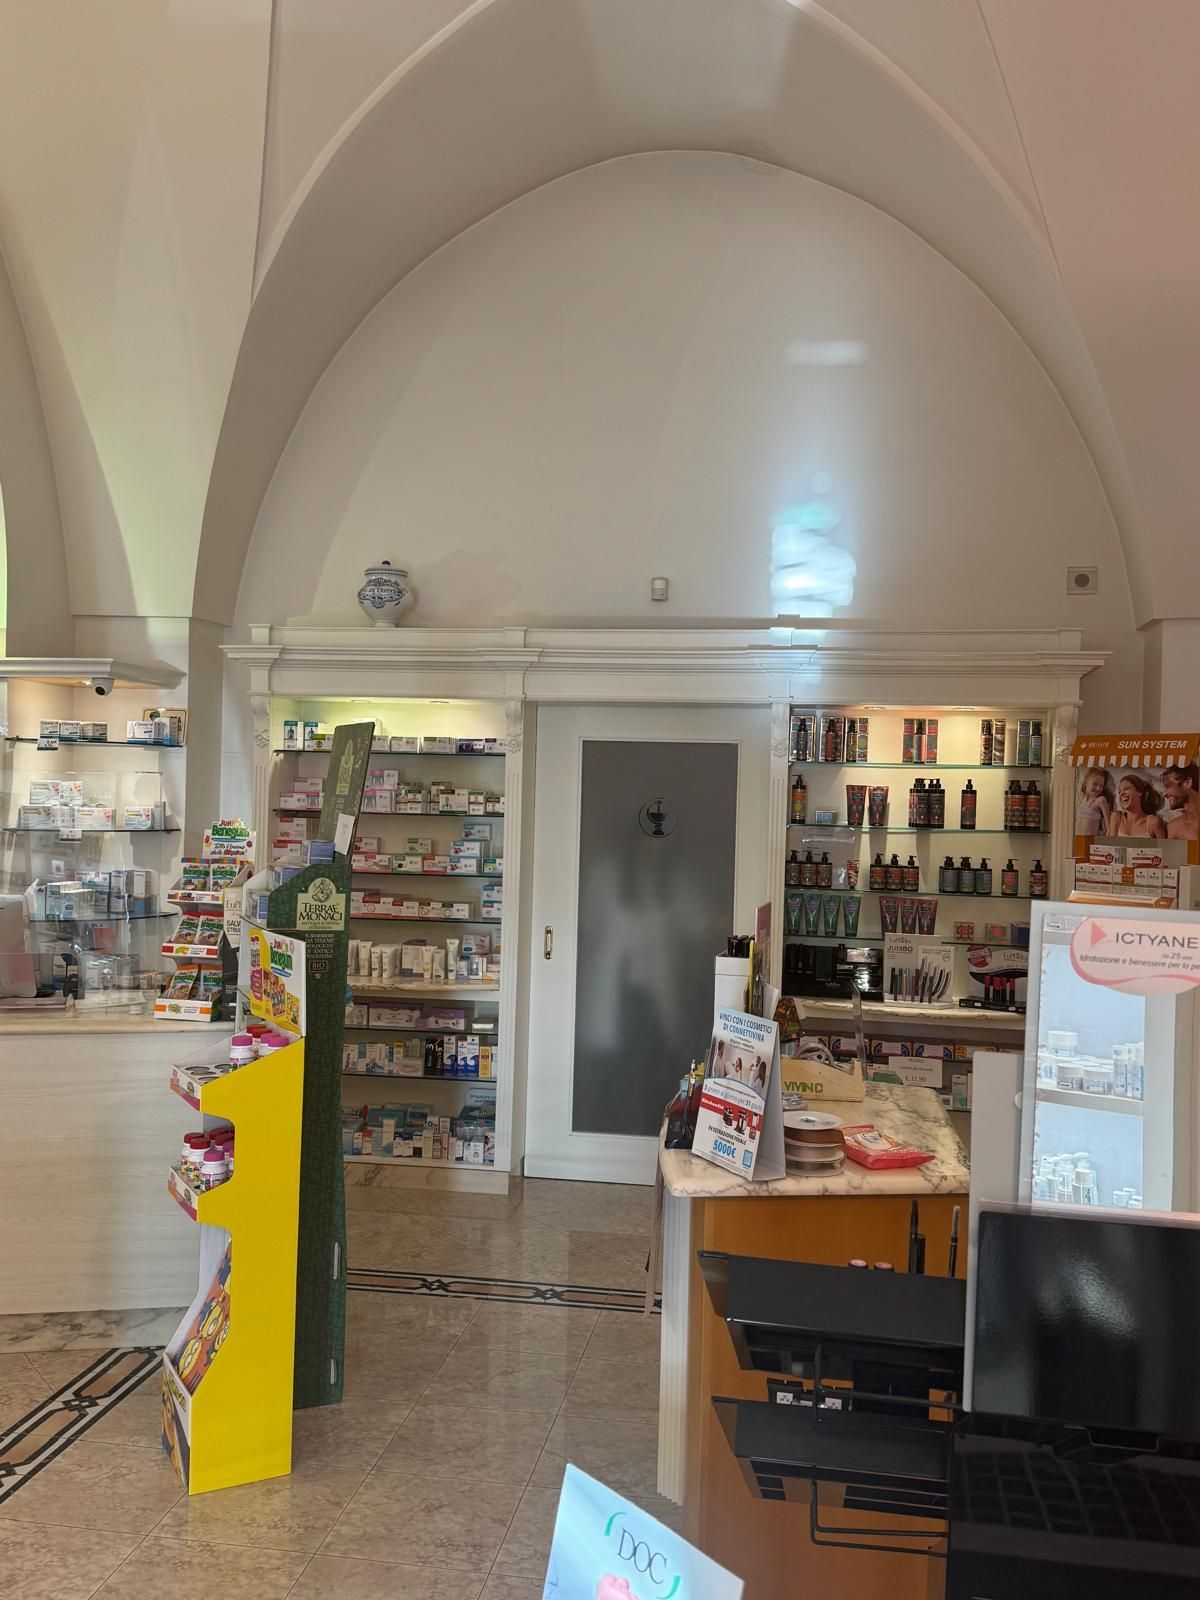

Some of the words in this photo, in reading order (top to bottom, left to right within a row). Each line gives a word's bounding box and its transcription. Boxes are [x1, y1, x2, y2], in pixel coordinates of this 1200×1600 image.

[1118, 741, 1140, 749] SUN
[1142, 740, 1188, 749] SYSTEM
[298, 912, 342, 921] MONACI
[302, 902, 338, 914] TERRAE
[1115, 931, 1200, 949] ICTYANE
[1128, 958, 1167, 968] benessere
[720, 1012, 733, 1022] VINCI
[733, 1016, 744, 1025] CON
[746, 1020, 772, 1034] COSMETICI
[729, 1024, 764, 1042] CONNETTIVINA
[713, 1140, 737, 1158] 5000€
[617, 1526, 668, 1584] DOC
